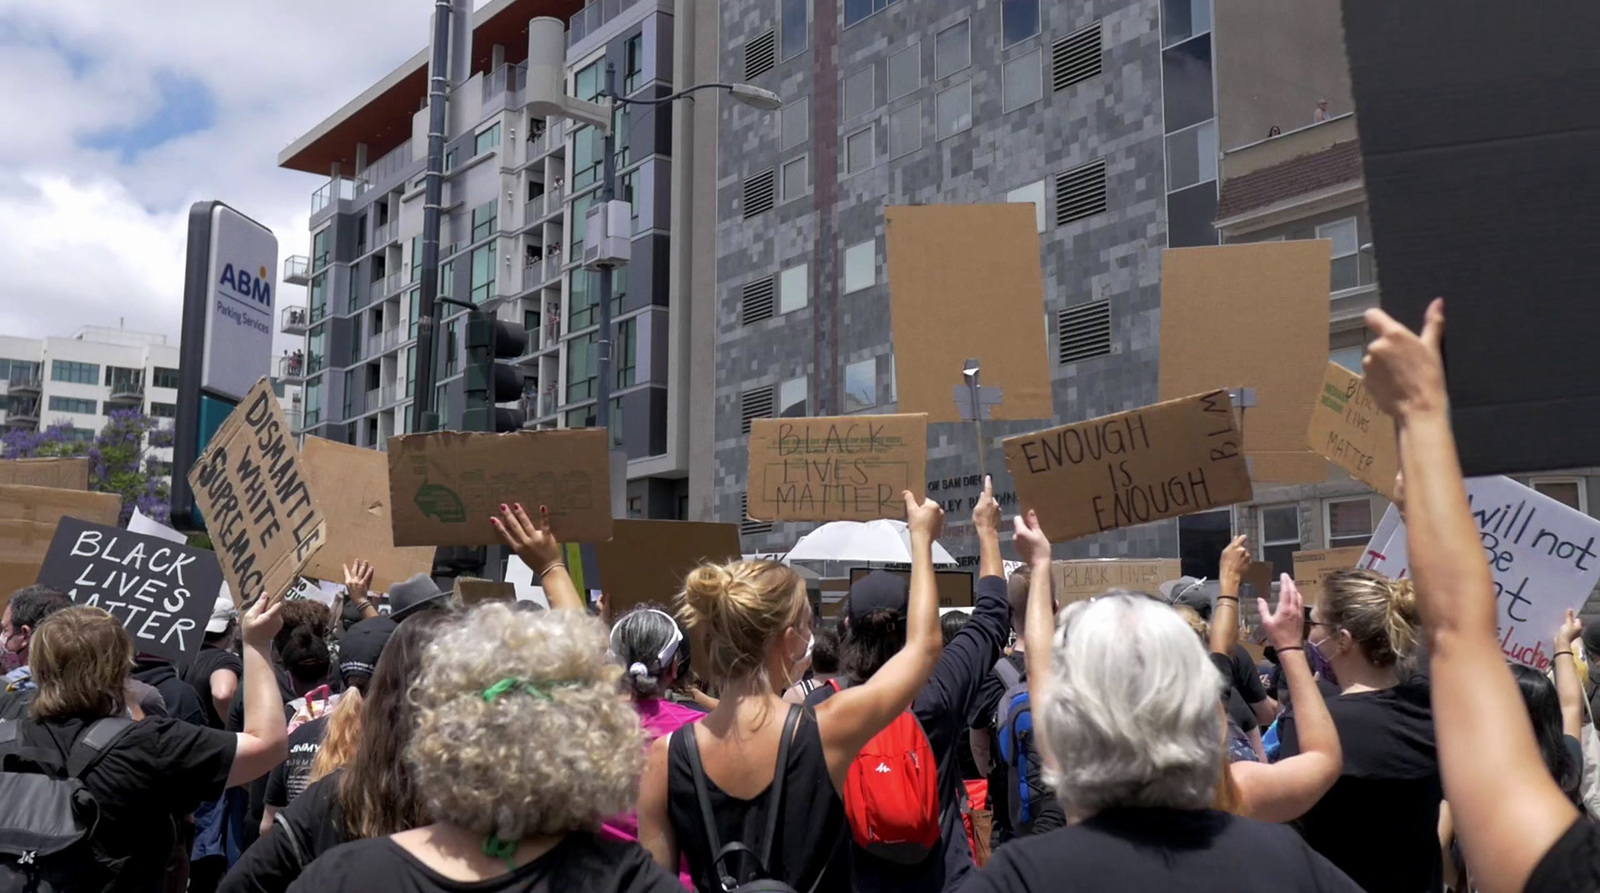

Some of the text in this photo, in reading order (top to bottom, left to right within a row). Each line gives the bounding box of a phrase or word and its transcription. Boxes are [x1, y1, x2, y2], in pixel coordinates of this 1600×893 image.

[219, 262, 271, 307] ABM
[216, 301, 270, 334] Parking Services
[778, 422, 890, 456] BLACK
[1021, 413, 1150, 474] ENOUGH
[1326, 431, 1374, 471] MATTER
[245, 389, 320, 563] DISMANTLE
[783, 457, 869, 485] LIVES
[927, 481, 940, 491] OF
[942, 477, 962, 490] SAN
[1107, 459, 1132, 492] IS
[236, 445, 281, 550] WHITE
[776, 483, 900, 515] MATTER
[939, 499, 962, 513] LEY
[1091, 467, 1212, 532] ENOUGH
[70, 530, 197, 586] BLACK
[955, 555, 980, 568] SERV
[1531, 528, 1598, 571] not
[74, 563, 192, 613] LIVES
[1063, 565, 1159, 588] BLACK LIVES
[68, 588, 196, 652] ATTER
